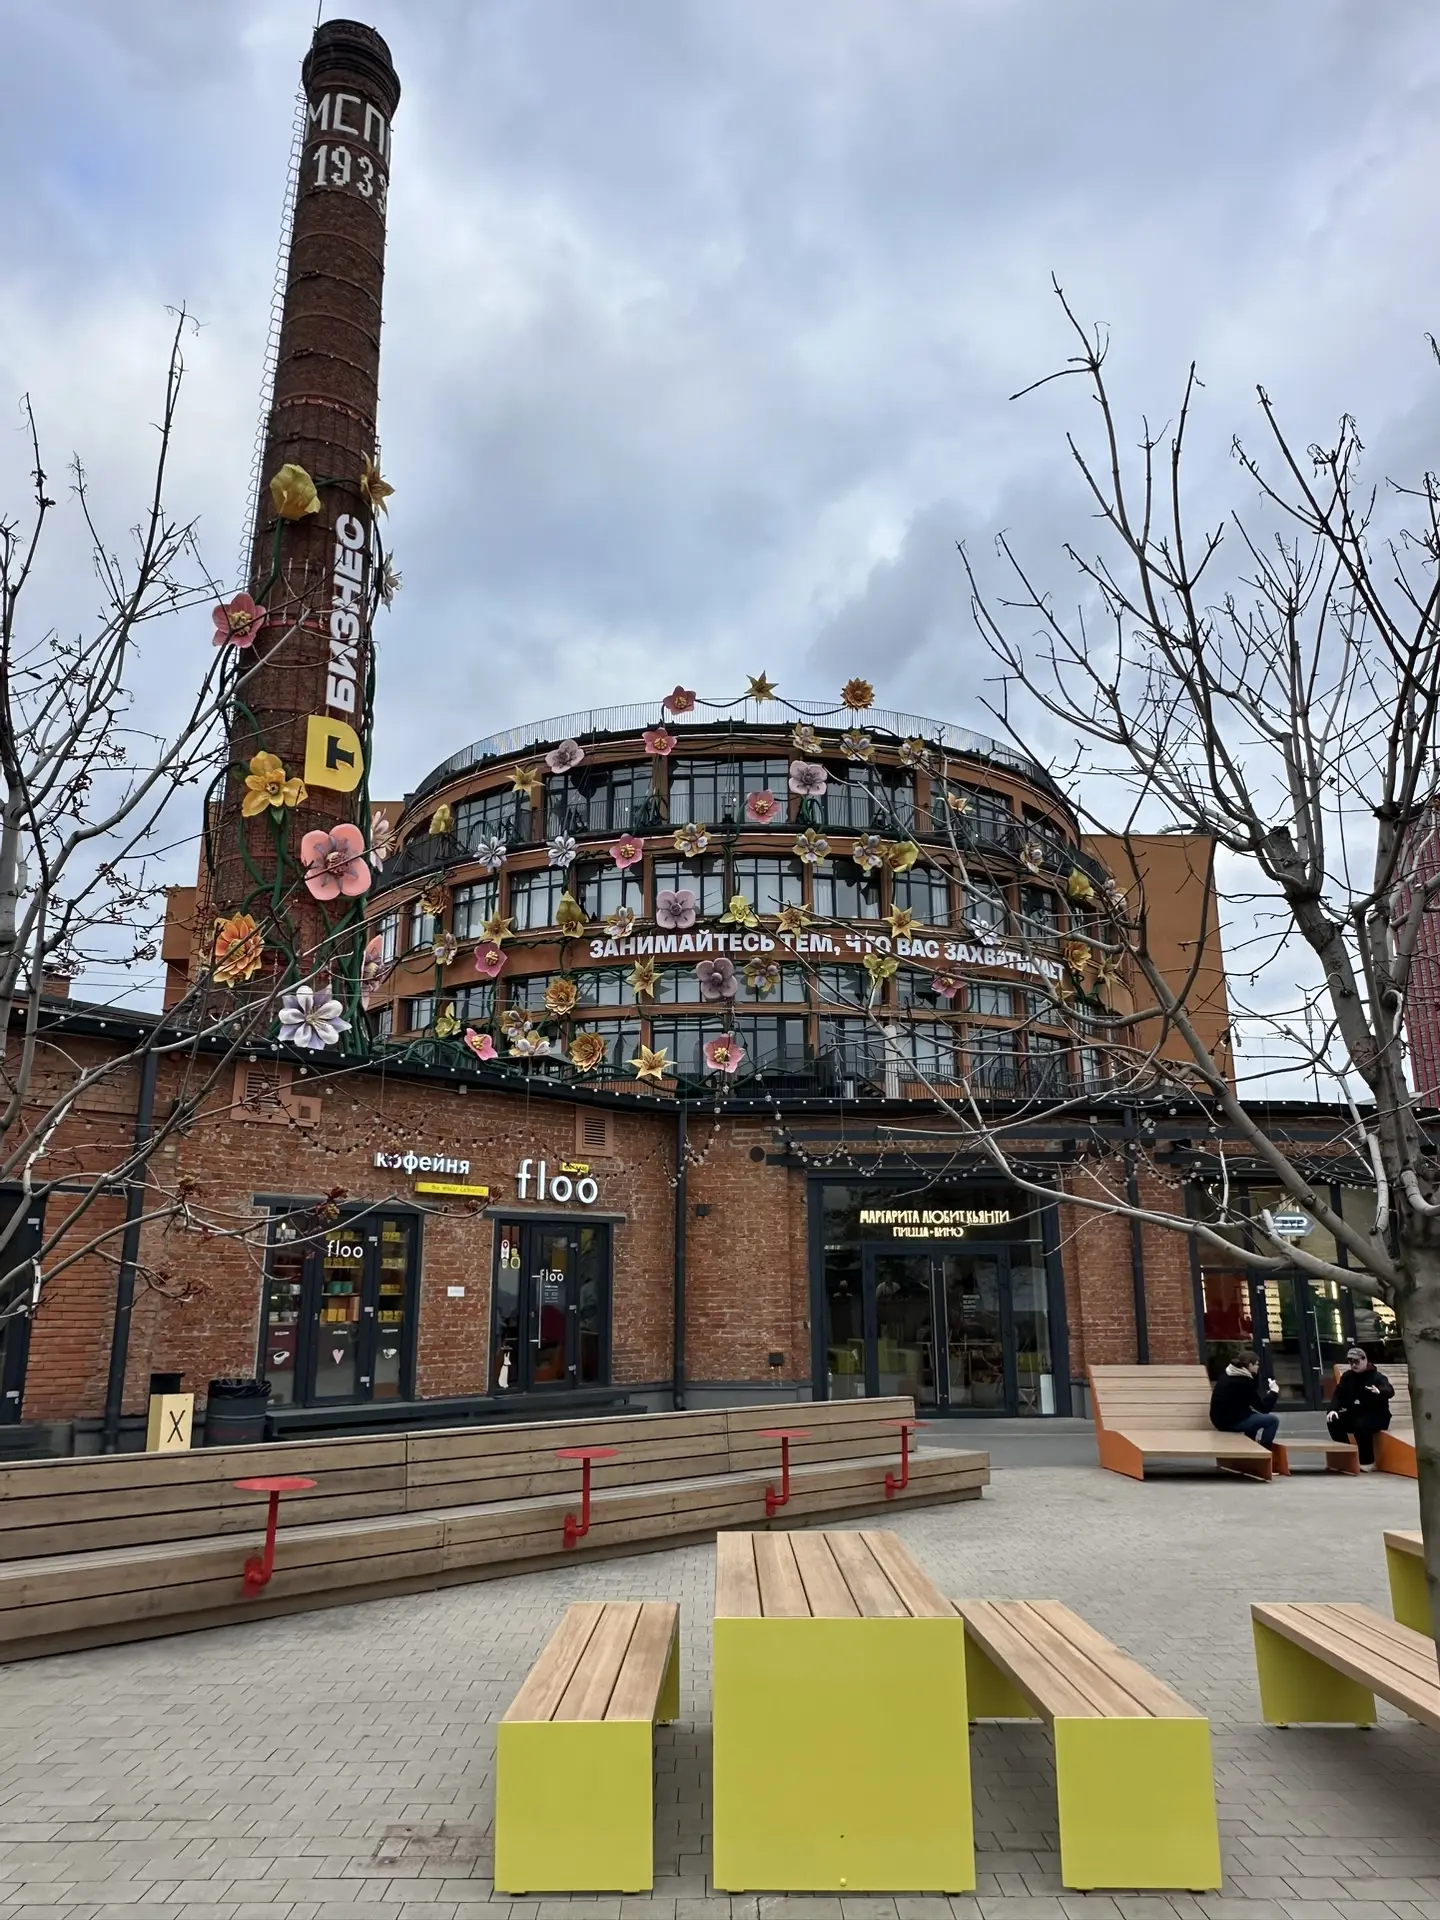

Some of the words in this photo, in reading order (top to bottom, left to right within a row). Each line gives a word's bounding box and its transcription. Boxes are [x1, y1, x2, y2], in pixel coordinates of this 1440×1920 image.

[304, 93, 391, 168] МСП
[326, 513, 365, 713] БИЗНЕС
[589, 929, 775, 958] ЗАНИМАЙТЕСЬ
[779, 933, 841, 956] ТЕМ,
[845, 934, 891, 954] ЧТО
[897, 938, 939, 959] ВАС
[374, 1150, 470, 1175] кофейня
[515, 1158, 598, 1204] floo
[860, 1210, 920, 1224] МАРГАРИТА
[922, 1210, 965, 1224] ЛЮБИТ
[966, 1210, 1010, 1224] КЬЯНТИ
[327, 1239, 364, 1258] floo
[540, 1269, 564, 1282] floo
